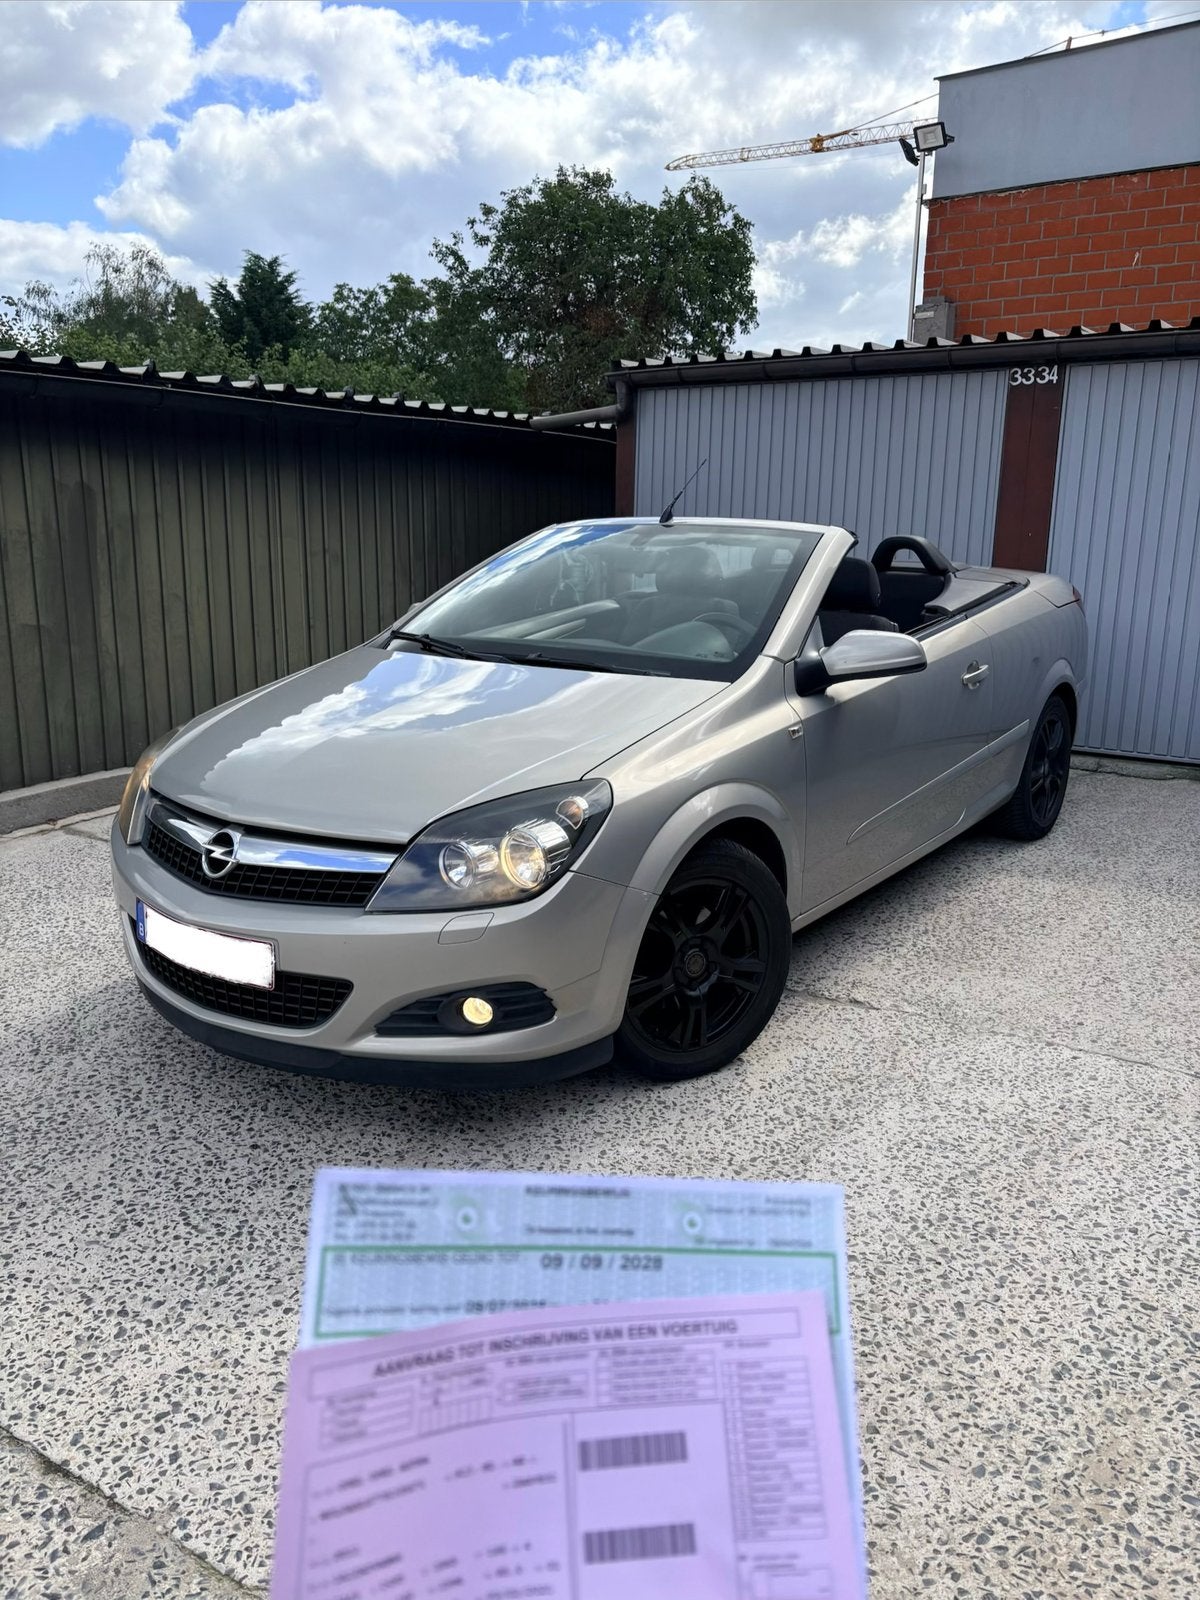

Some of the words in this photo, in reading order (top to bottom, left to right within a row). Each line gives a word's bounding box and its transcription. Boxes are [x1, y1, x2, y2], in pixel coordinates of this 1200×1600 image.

[373, 1346, 455, 1378] AANVRAAG
[458, 1341, 485, 1359] TOT
[489, 1328, 590, 1352] INSCHRIJVING
[593, 1325, 623, 1342] VAN
[628, 1323, 657, 1340] EEN
[661, 1318, 738, 1338] VOERTUIG
